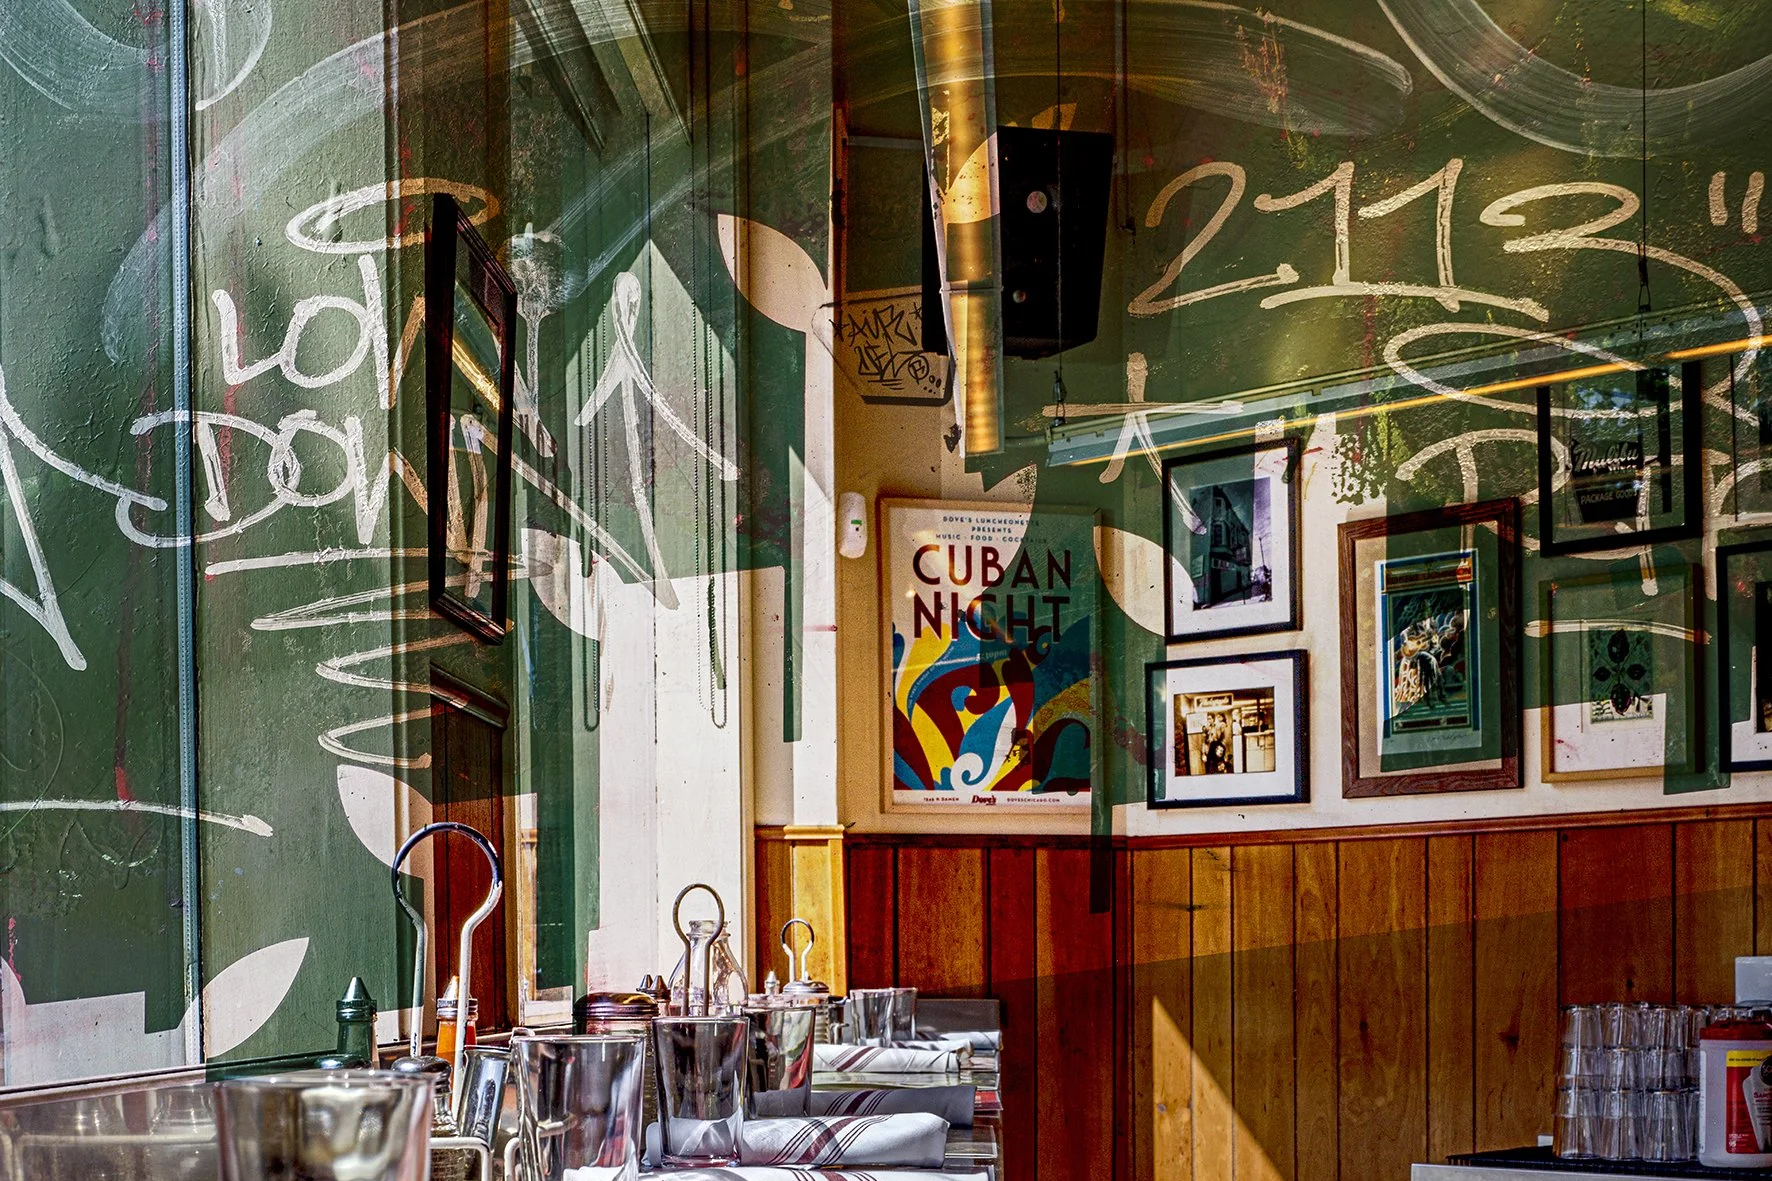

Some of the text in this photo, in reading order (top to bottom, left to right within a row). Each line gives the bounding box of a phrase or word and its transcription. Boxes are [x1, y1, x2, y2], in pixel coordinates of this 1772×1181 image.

[935, 533, 961, 541] MUSIC
[970, 534, 993, 542] FOOD
[971, 526, 1012, 534] PRESENTS
[912, 543, 1072, 591] CUBAN
[912, 590, 1072, 644] NIGHT
